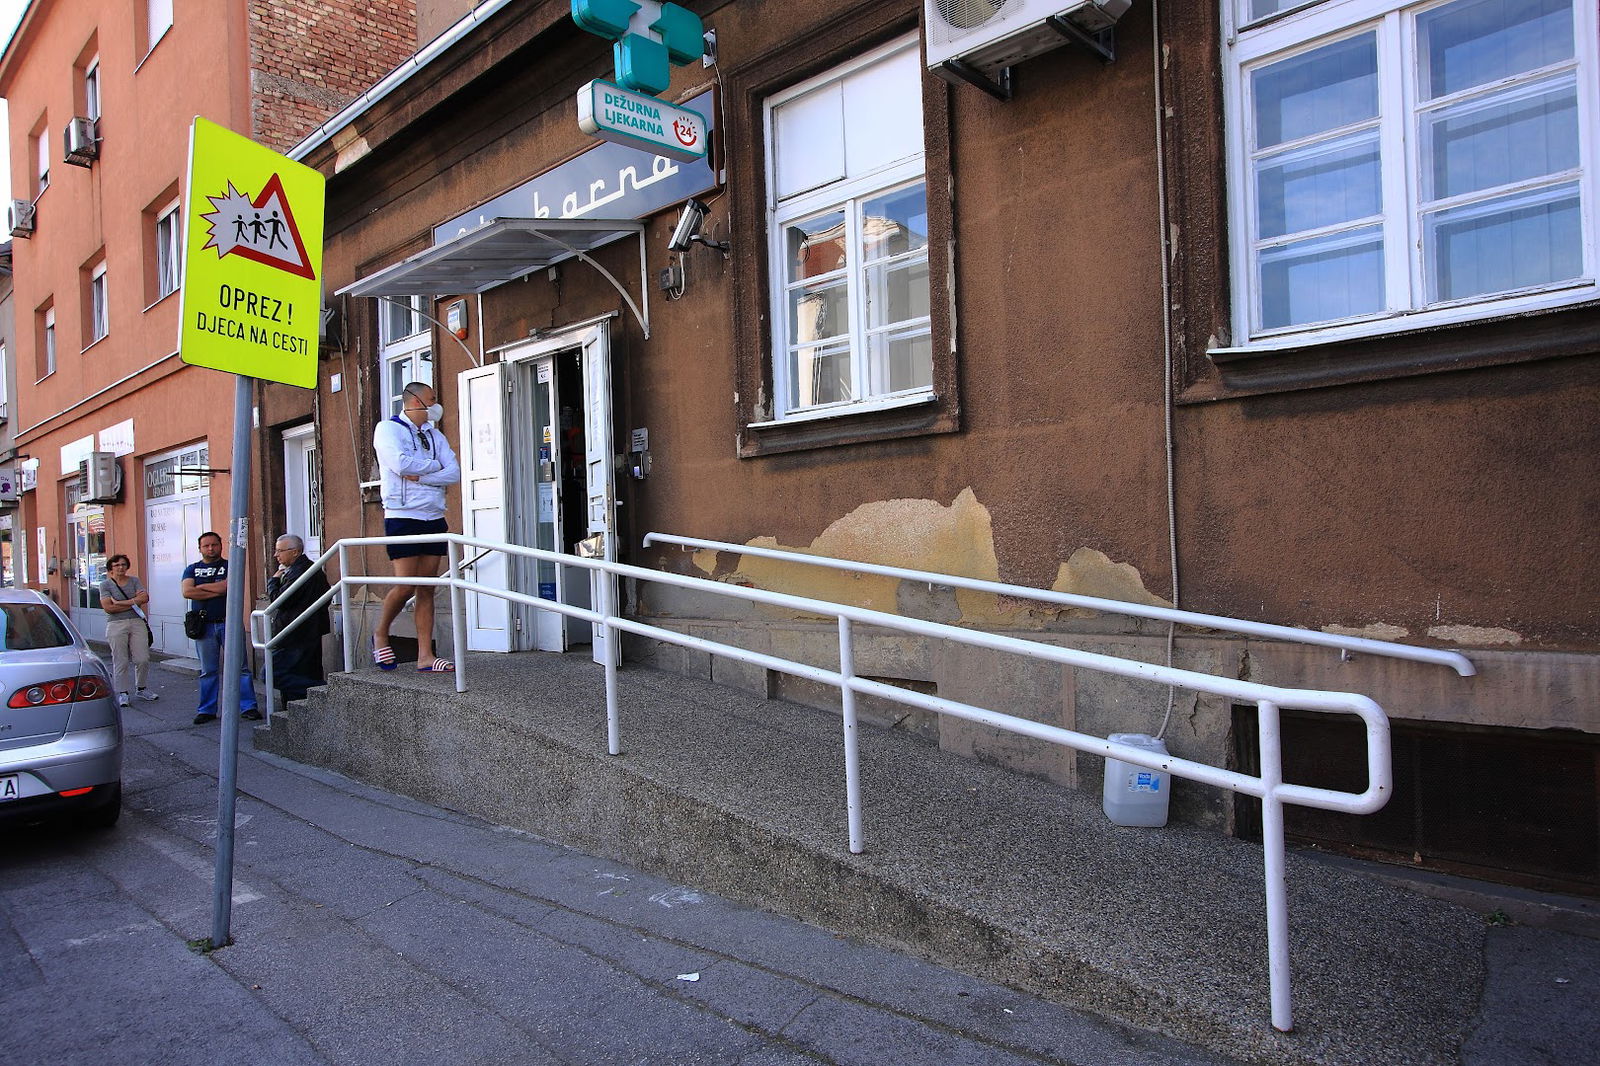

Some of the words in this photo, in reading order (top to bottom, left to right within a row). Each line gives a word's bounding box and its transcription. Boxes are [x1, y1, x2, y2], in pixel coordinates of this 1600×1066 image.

[605, 93, 662, 121] DEŽURNA
[605, 108, 665, 136] LJEKARNA
[680, 125, 692, 137] 24
[197, 311, 245, 340] DJECA
[249, 325, 268, 346] NA
[272, 331, 308, 355] CESTI
